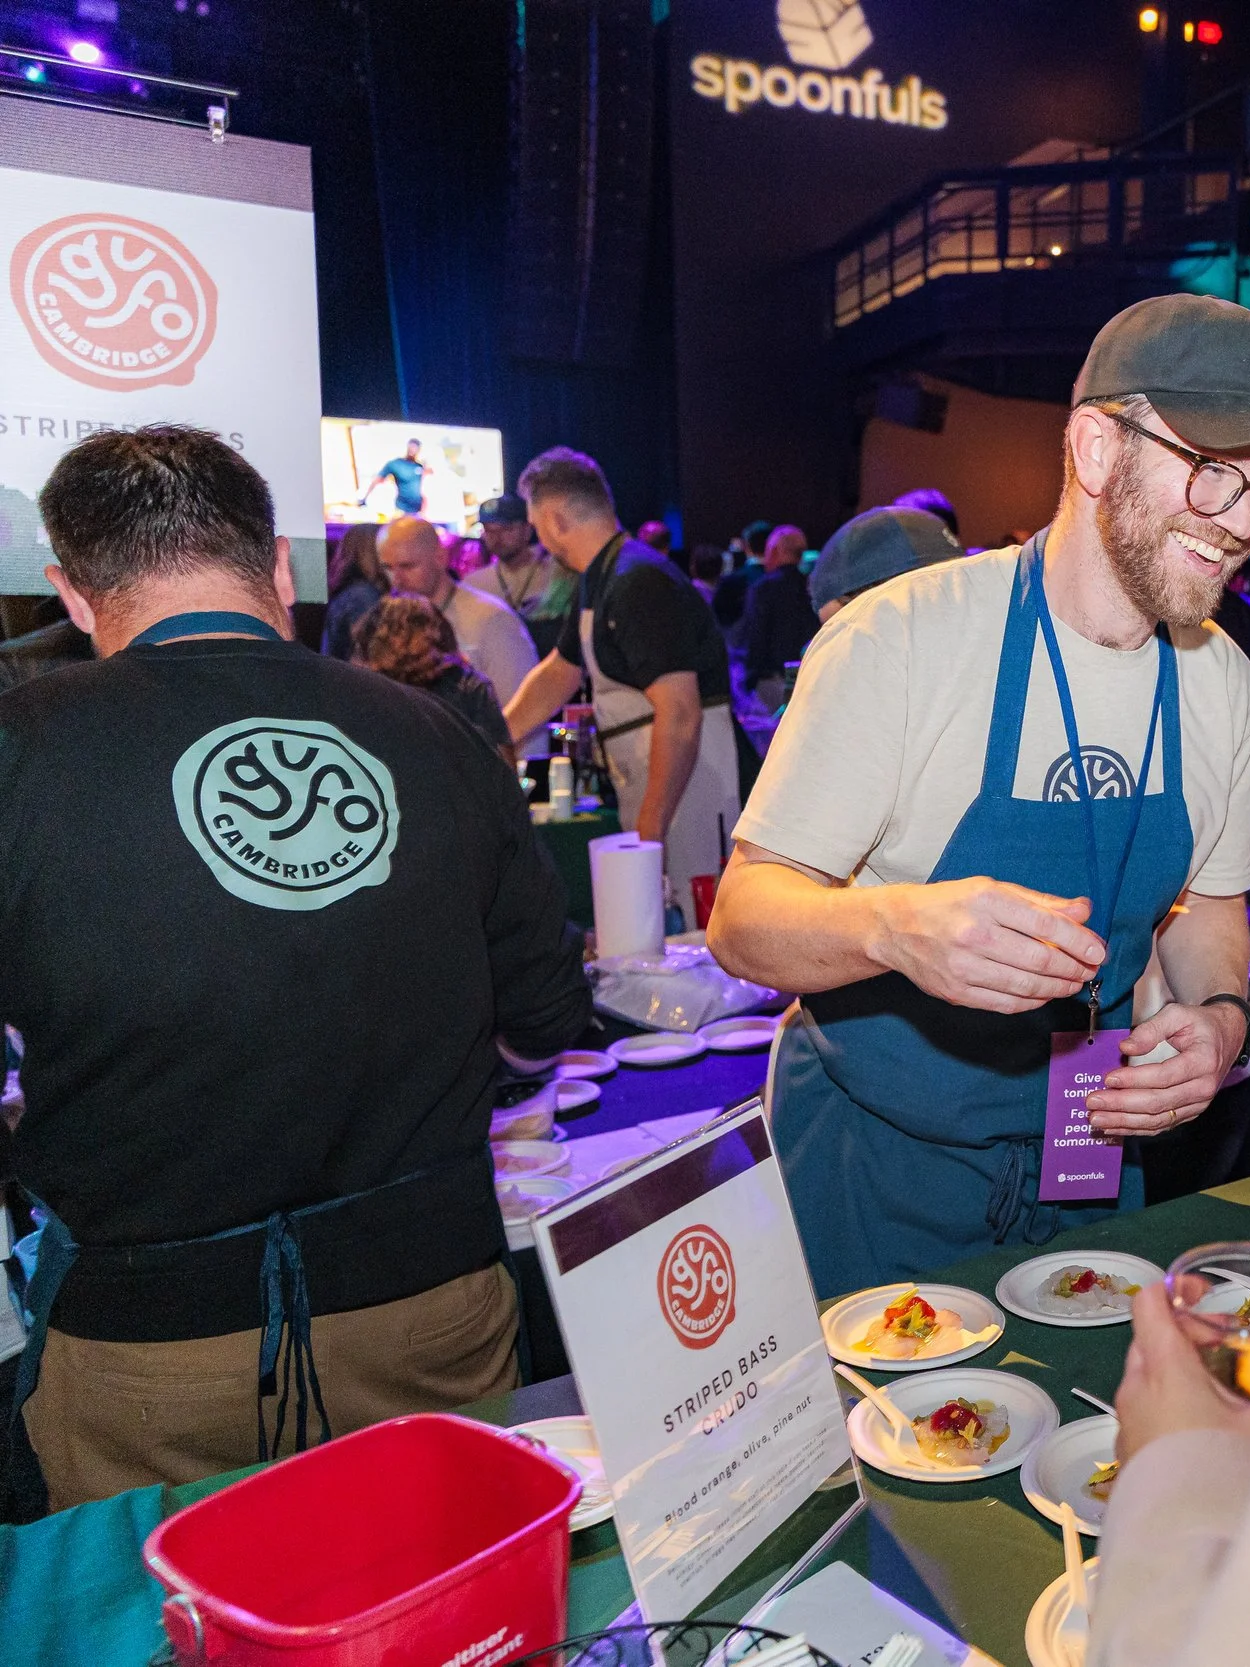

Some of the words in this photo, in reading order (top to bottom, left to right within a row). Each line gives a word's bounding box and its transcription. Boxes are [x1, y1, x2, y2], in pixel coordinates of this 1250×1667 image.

[691, 53, 948, 129] spoonfuls
[48, 233, 194, 341] gufo
[38, 291, 172, 367] CAMBRIDGE
[217, 739, 380, 841] gufo
[212, 812, 364, 880] CAMBRIDGE
[1074, 1072, 1102, 1084] Give
[1066, 1172, 1105, 1182] spoonfuls
[671, 1241, 728, 1311] gufo
[671, 1299, 726, 1330] CAMBRIDGE
[663, 1369, 733, 1434] STRIPED
[738, 1335, 777, 1376] BASS
[702, 1381, 758, 1435] CRUDO
[664, 1491, 698, 1523] Blood
[701, 1461, 741, 1497] orange,
[743, 1435, 771, 1459] olive,
[772, 1411, 794, 1437] pine
[796, 1395, 812, 1415] nut
